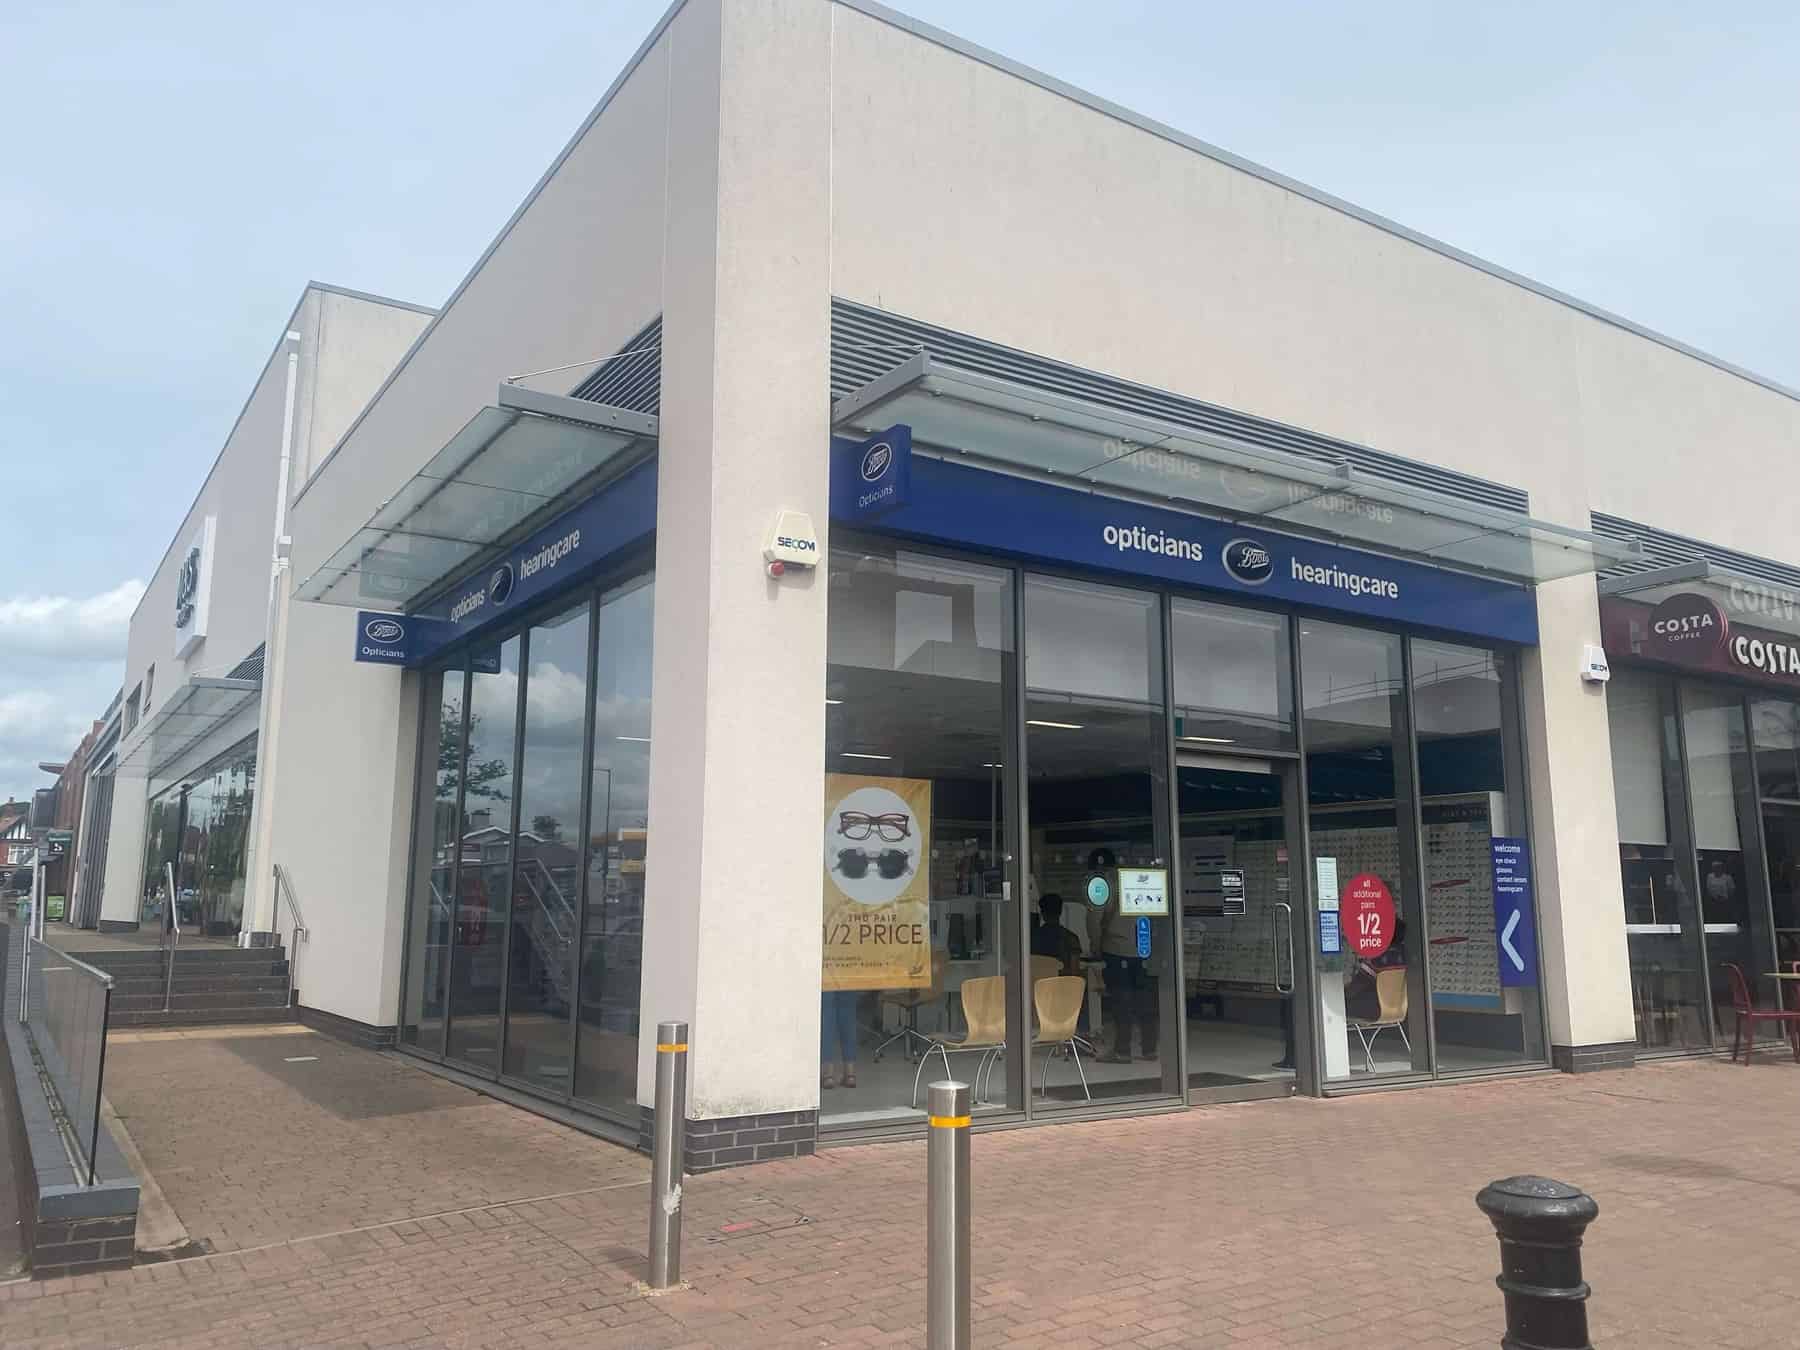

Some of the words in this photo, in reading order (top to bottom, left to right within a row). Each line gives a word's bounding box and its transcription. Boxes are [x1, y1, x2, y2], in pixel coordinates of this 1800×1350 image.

[859, 485, 893, 508] Opticians
[777, 536, 816, 551] SECOM
[1103, 525, 1203, 562] opticians
[1291, 557, 1399, 599] hearingcare
[450, 588, 486, 623] opticians
[520, 529, 581, 581] hearingcare
[1654, 613, 1713, 634] COSTA
[1668, 632, 1701, 642] COFFEE
[362, 646, 405, 658] Opticians
[1735, 636, 1800, 674] COSTA
[1494, 844, 1520, 853] welcome
[1353, 890, 1382, 898] additional
[873, 914, 897, 922] PAIR
[1357, 912, 1381, 935] 1/2
[859, 924, 923, 945] PRICE
[1360, 936, 1382, 949] price
